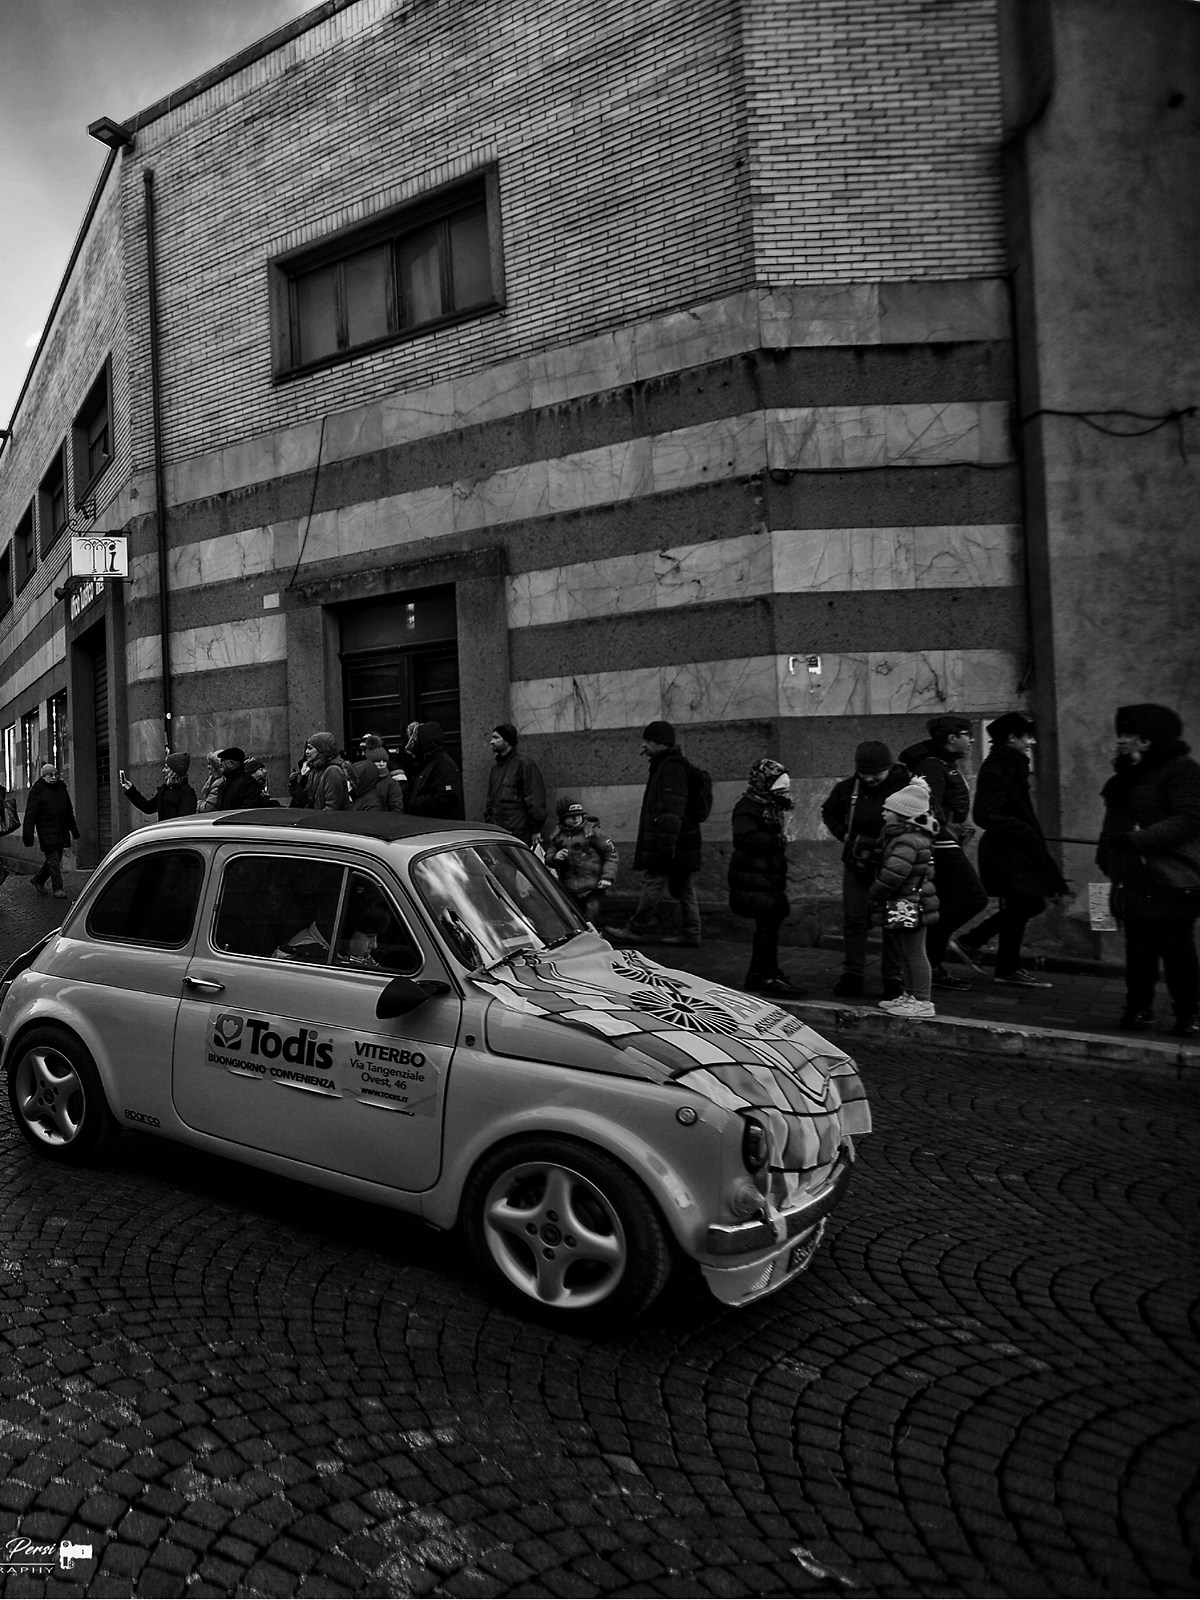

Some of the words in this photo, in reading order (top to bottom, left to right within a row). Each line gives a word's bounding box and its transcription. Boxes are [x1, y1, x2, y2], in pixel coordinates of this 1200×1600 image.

[246, 1018, 333, 1070] Todis
[354, 1041, 426, 1068] VITERBO
[208, 1053, 267, 1074] BUONGIORNO
[269, 1067, 336, 1090] CONVENIENZA
[350, 1058, 364, 1070] Via
[366, 1061, 425, 1082] Tangenziale
[361, 1072, 391, 1088] Ovest,
[394, 1080, 407, 1090] 46
